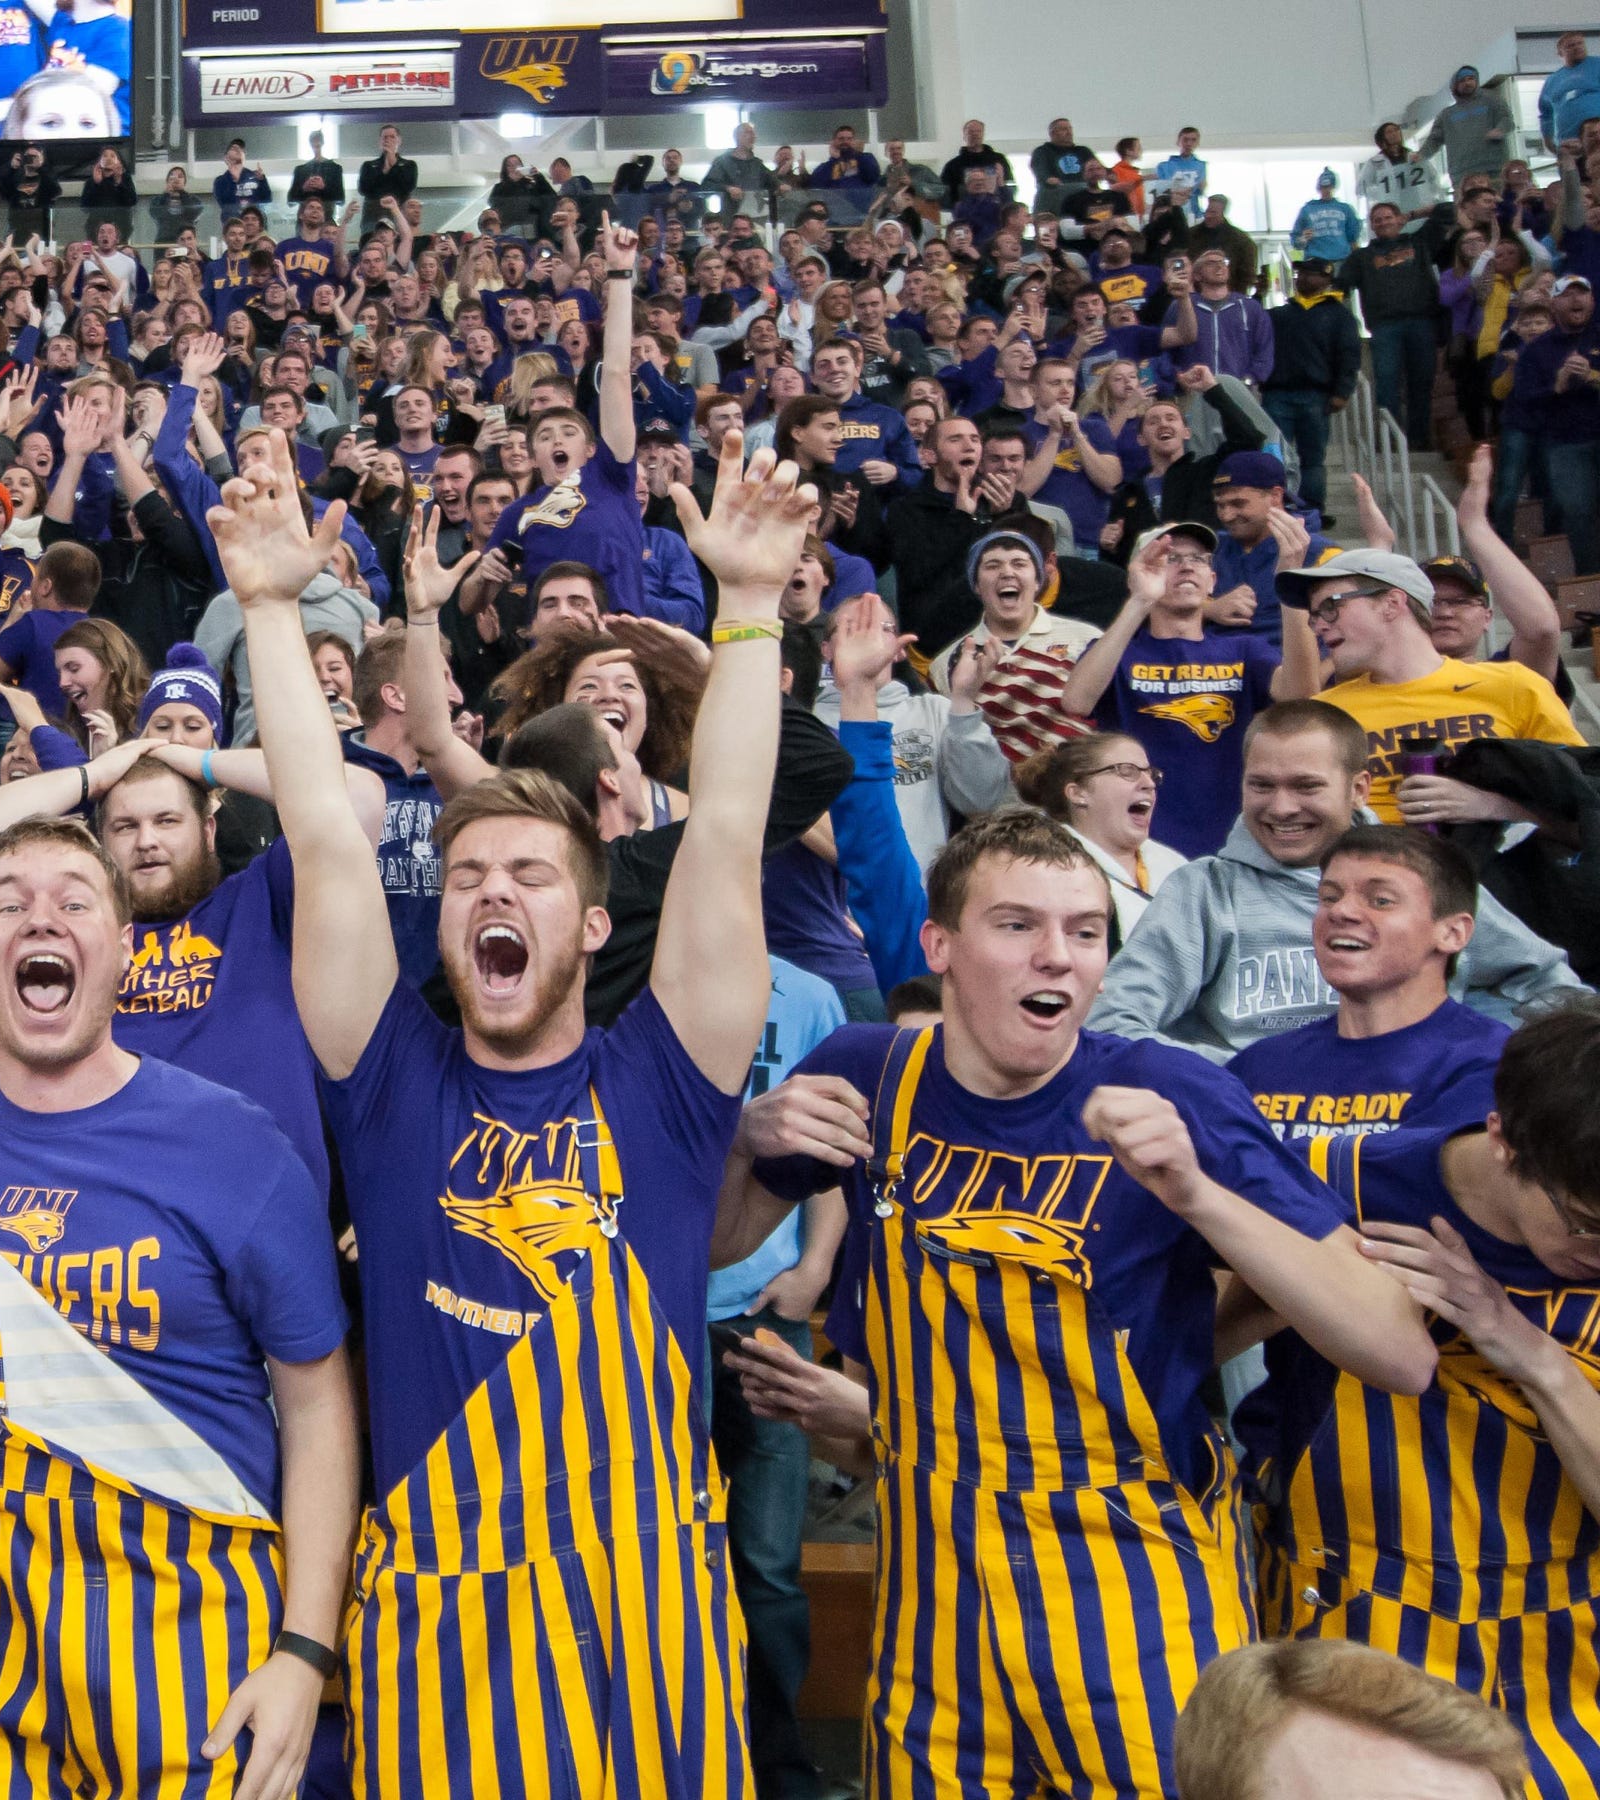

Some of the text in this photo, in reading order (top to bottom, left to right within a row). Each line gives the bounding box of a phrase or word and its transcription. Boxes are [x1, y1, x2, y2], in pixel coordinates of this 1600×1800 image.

[212, 9, 259, 22] PERIOD
[480, 37, 579, 77] UNI
[688, 75, 712, 86] abc
[710, 61, 818, 78] kcrg.com
[212, 76, 295, 96] LENNOX
[329, 71, 450, 93] PETERSEN
[1380, 167, 1426, 194] 112
[284, 250, 331, 277] UNI
[1131, 660, 1246, 681] GET READY
[1131, 679, 1166, 694] FOR
[1367, 712, 1500, 757] NTHER
[1252, 1092, 1413, 1125] GET READY
[902, 1131, 1114, 1232] UNI
[424, 1279, 522, 1337] PANTHER
